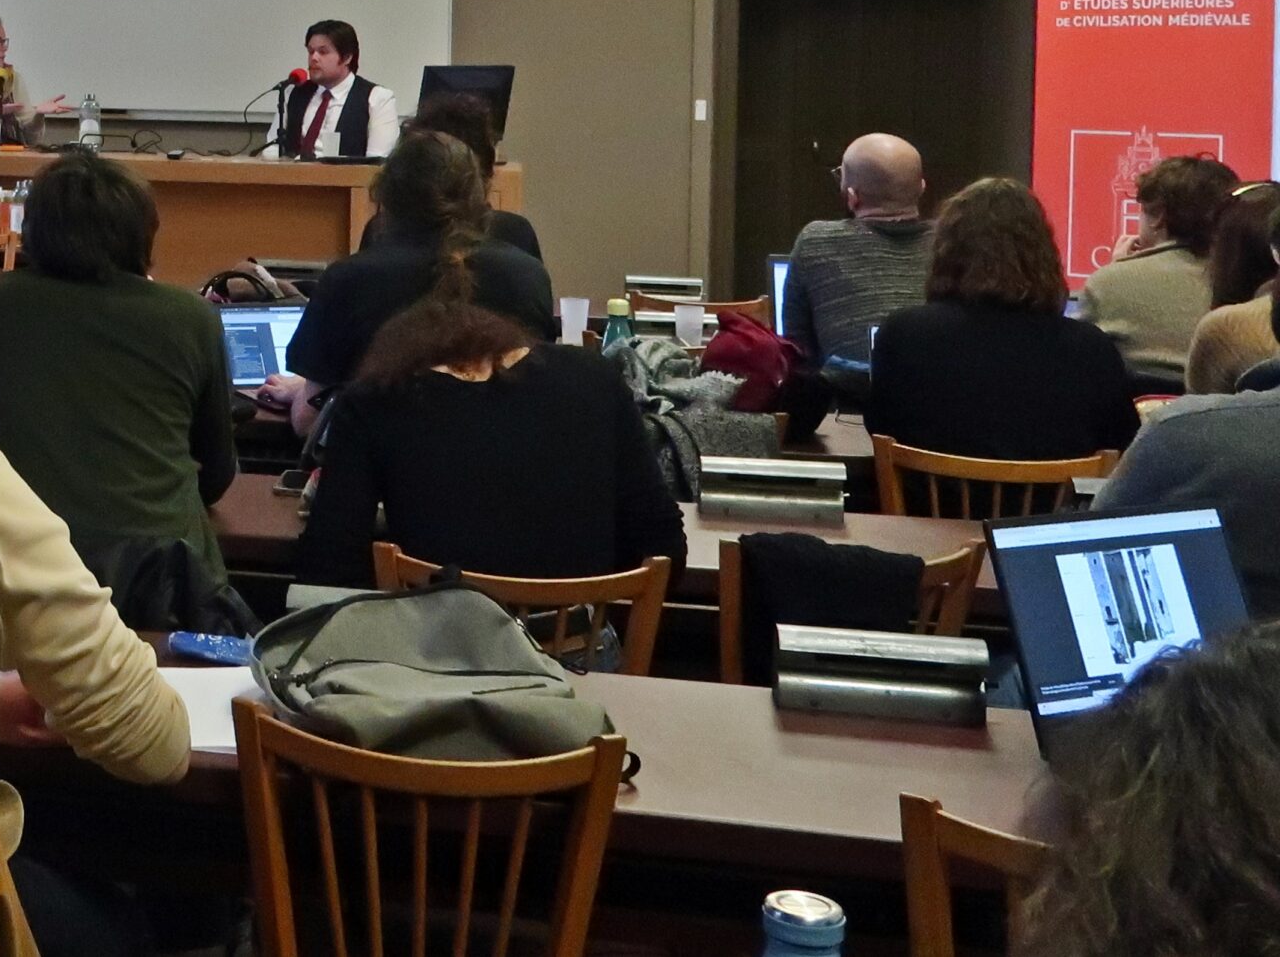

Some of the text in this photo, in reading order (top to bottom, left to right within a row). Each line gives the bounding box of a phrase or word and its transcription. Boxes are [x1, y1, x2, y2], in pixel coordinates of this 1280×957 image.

[1055, 11, 1251, 27] DE CIVILISATION MÉDIÉVALE
